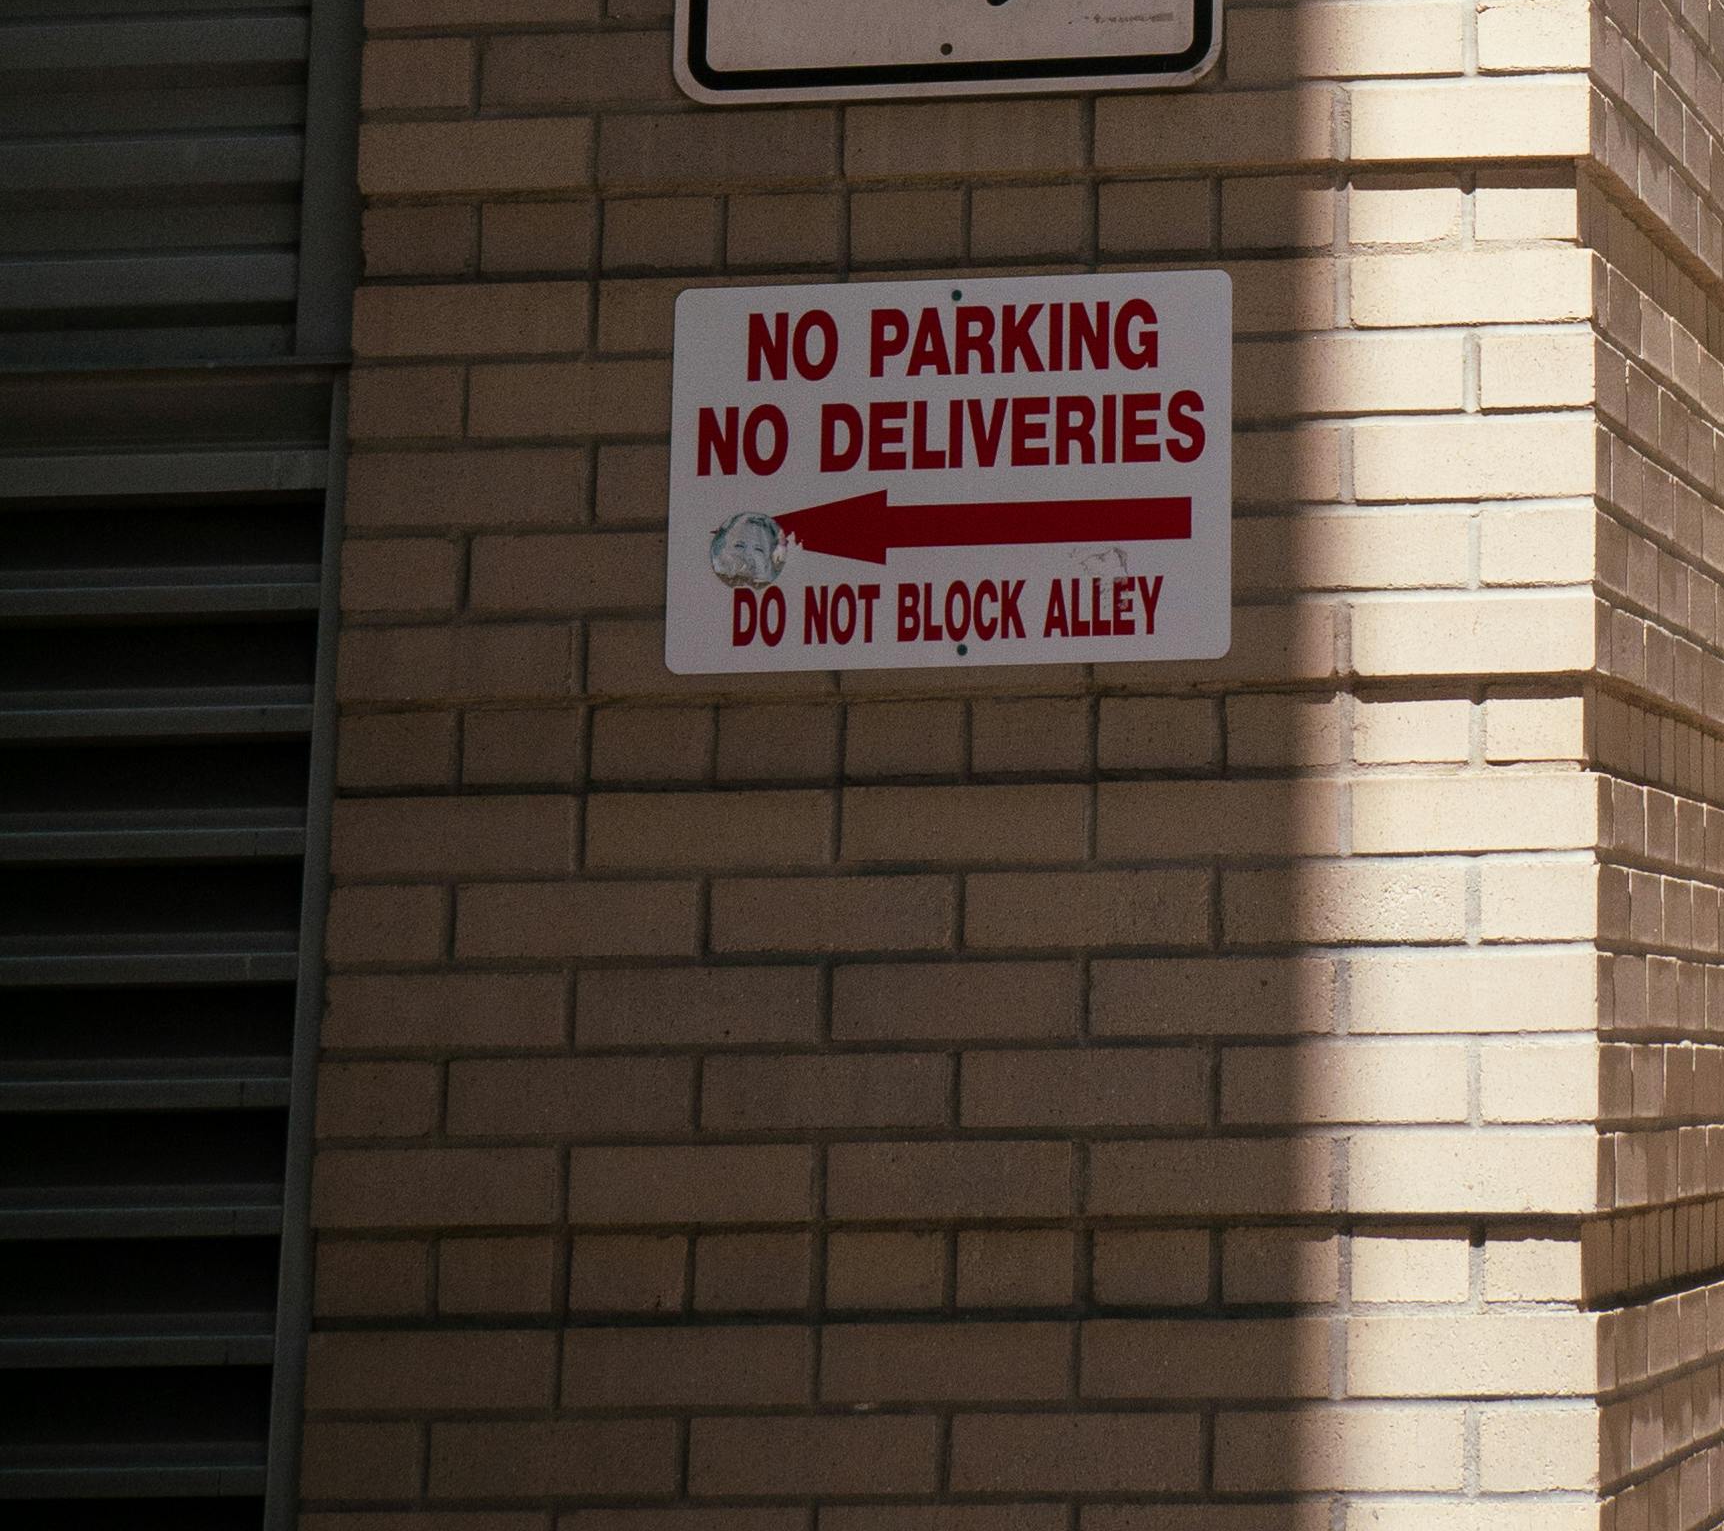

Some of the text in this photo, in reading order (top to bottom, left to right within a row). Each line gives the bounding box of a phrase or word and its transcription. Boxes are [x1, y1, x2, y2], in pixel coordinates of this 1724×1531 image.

[746, 298, 1159, 381] NO PARKING
[696, 389, 1206, 476] NO DELIVERIES
[732, 576, 1164, 648] DO NOT BLOCK ALLEY
